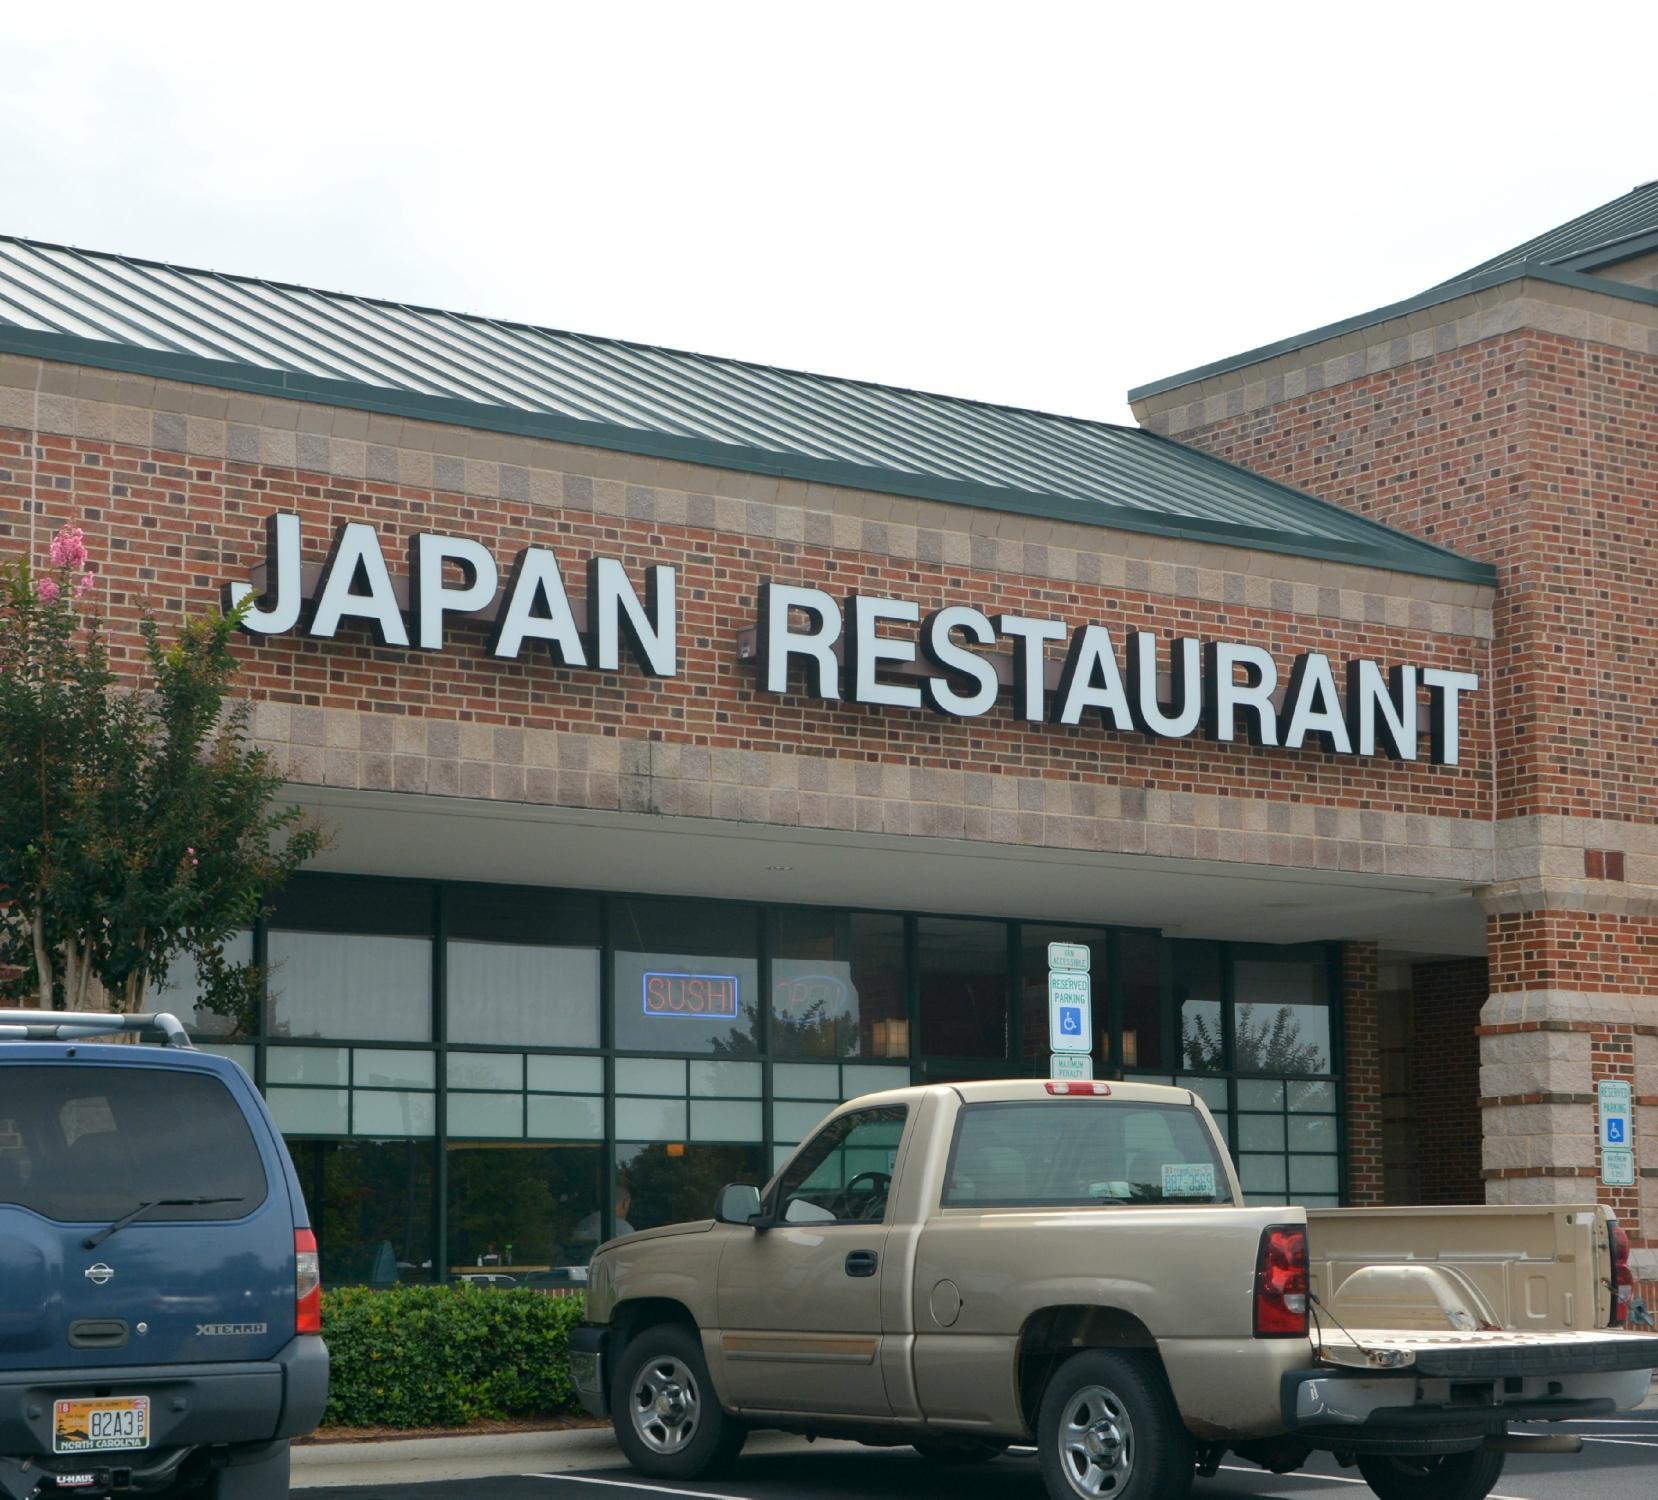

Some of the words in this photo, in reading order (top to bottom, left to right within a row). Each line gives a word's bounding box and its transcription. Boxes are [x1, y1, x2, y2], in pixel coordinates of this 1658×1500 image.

[224, 512, 678, 678] JAPAN
[759, 582, 1480, 765] RESTAURANT
[1053, 957, 1087, 967] ACCESSIBLE
[1052, 978, 1088, 991] RESERVED
[647, 976, 735, 1013] SUSHI
[1054, 993, 1086, 1005] PARKING
[1058, 1060, 1084, 1069] MAXIMUM
[1058, 1070, 1084, 1079] PENALTY
[196, 1322, 267, 1336] XTERRA
[91, 1411, 133, 1437] 82A3
[61, 1440, 94, 1450] NORTH
[96, 1438, 142, 1448] CAROLINA
[56, 1474, 95, 1483] U-HAUL
